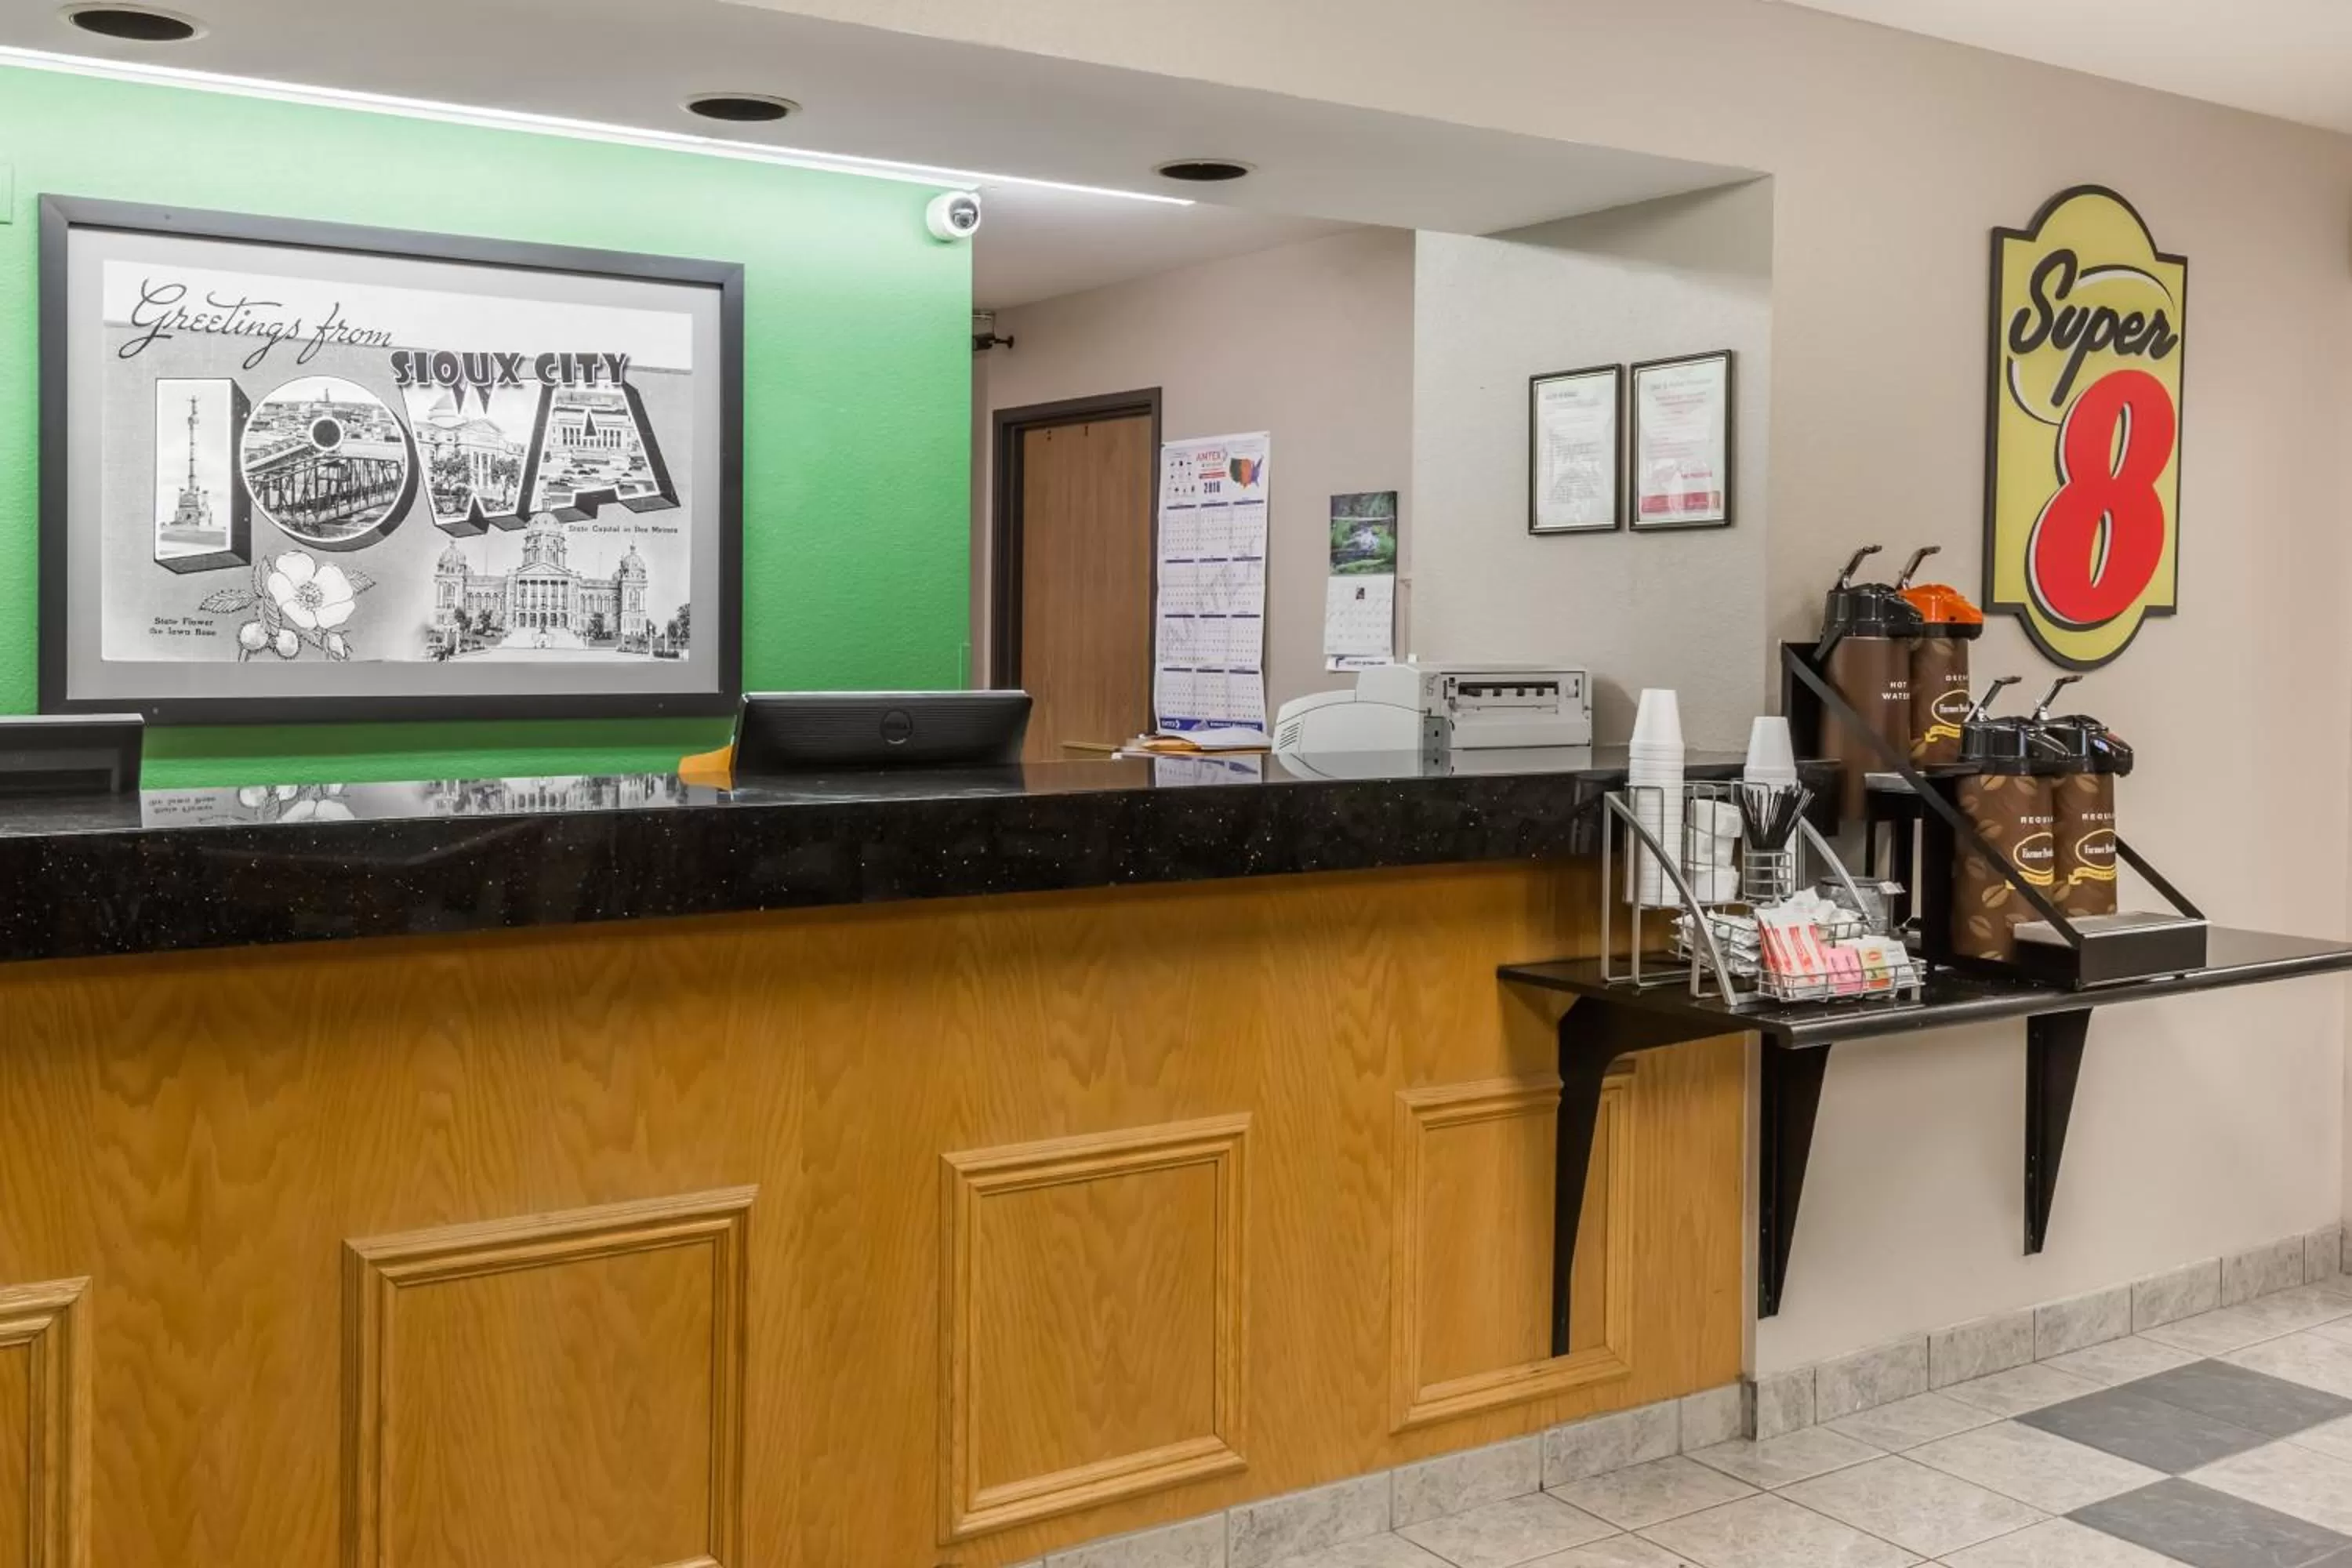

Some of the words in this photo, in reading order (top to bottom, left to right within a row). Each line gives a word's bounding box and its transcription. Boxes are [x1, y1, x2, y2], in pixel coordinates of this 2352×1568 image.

[118, 278, 302, 370] Greetings
[296, 301, 392, 365] from
[390, 350, 523, 387] SIOUX
[533, 352, 630, 387] CITY
[2009, 248, 2179, 407] Super
[2024, 368, 2176, 632] 8
[154, 616, 179, 625] State
[183, 617, 213, 626] Flower
